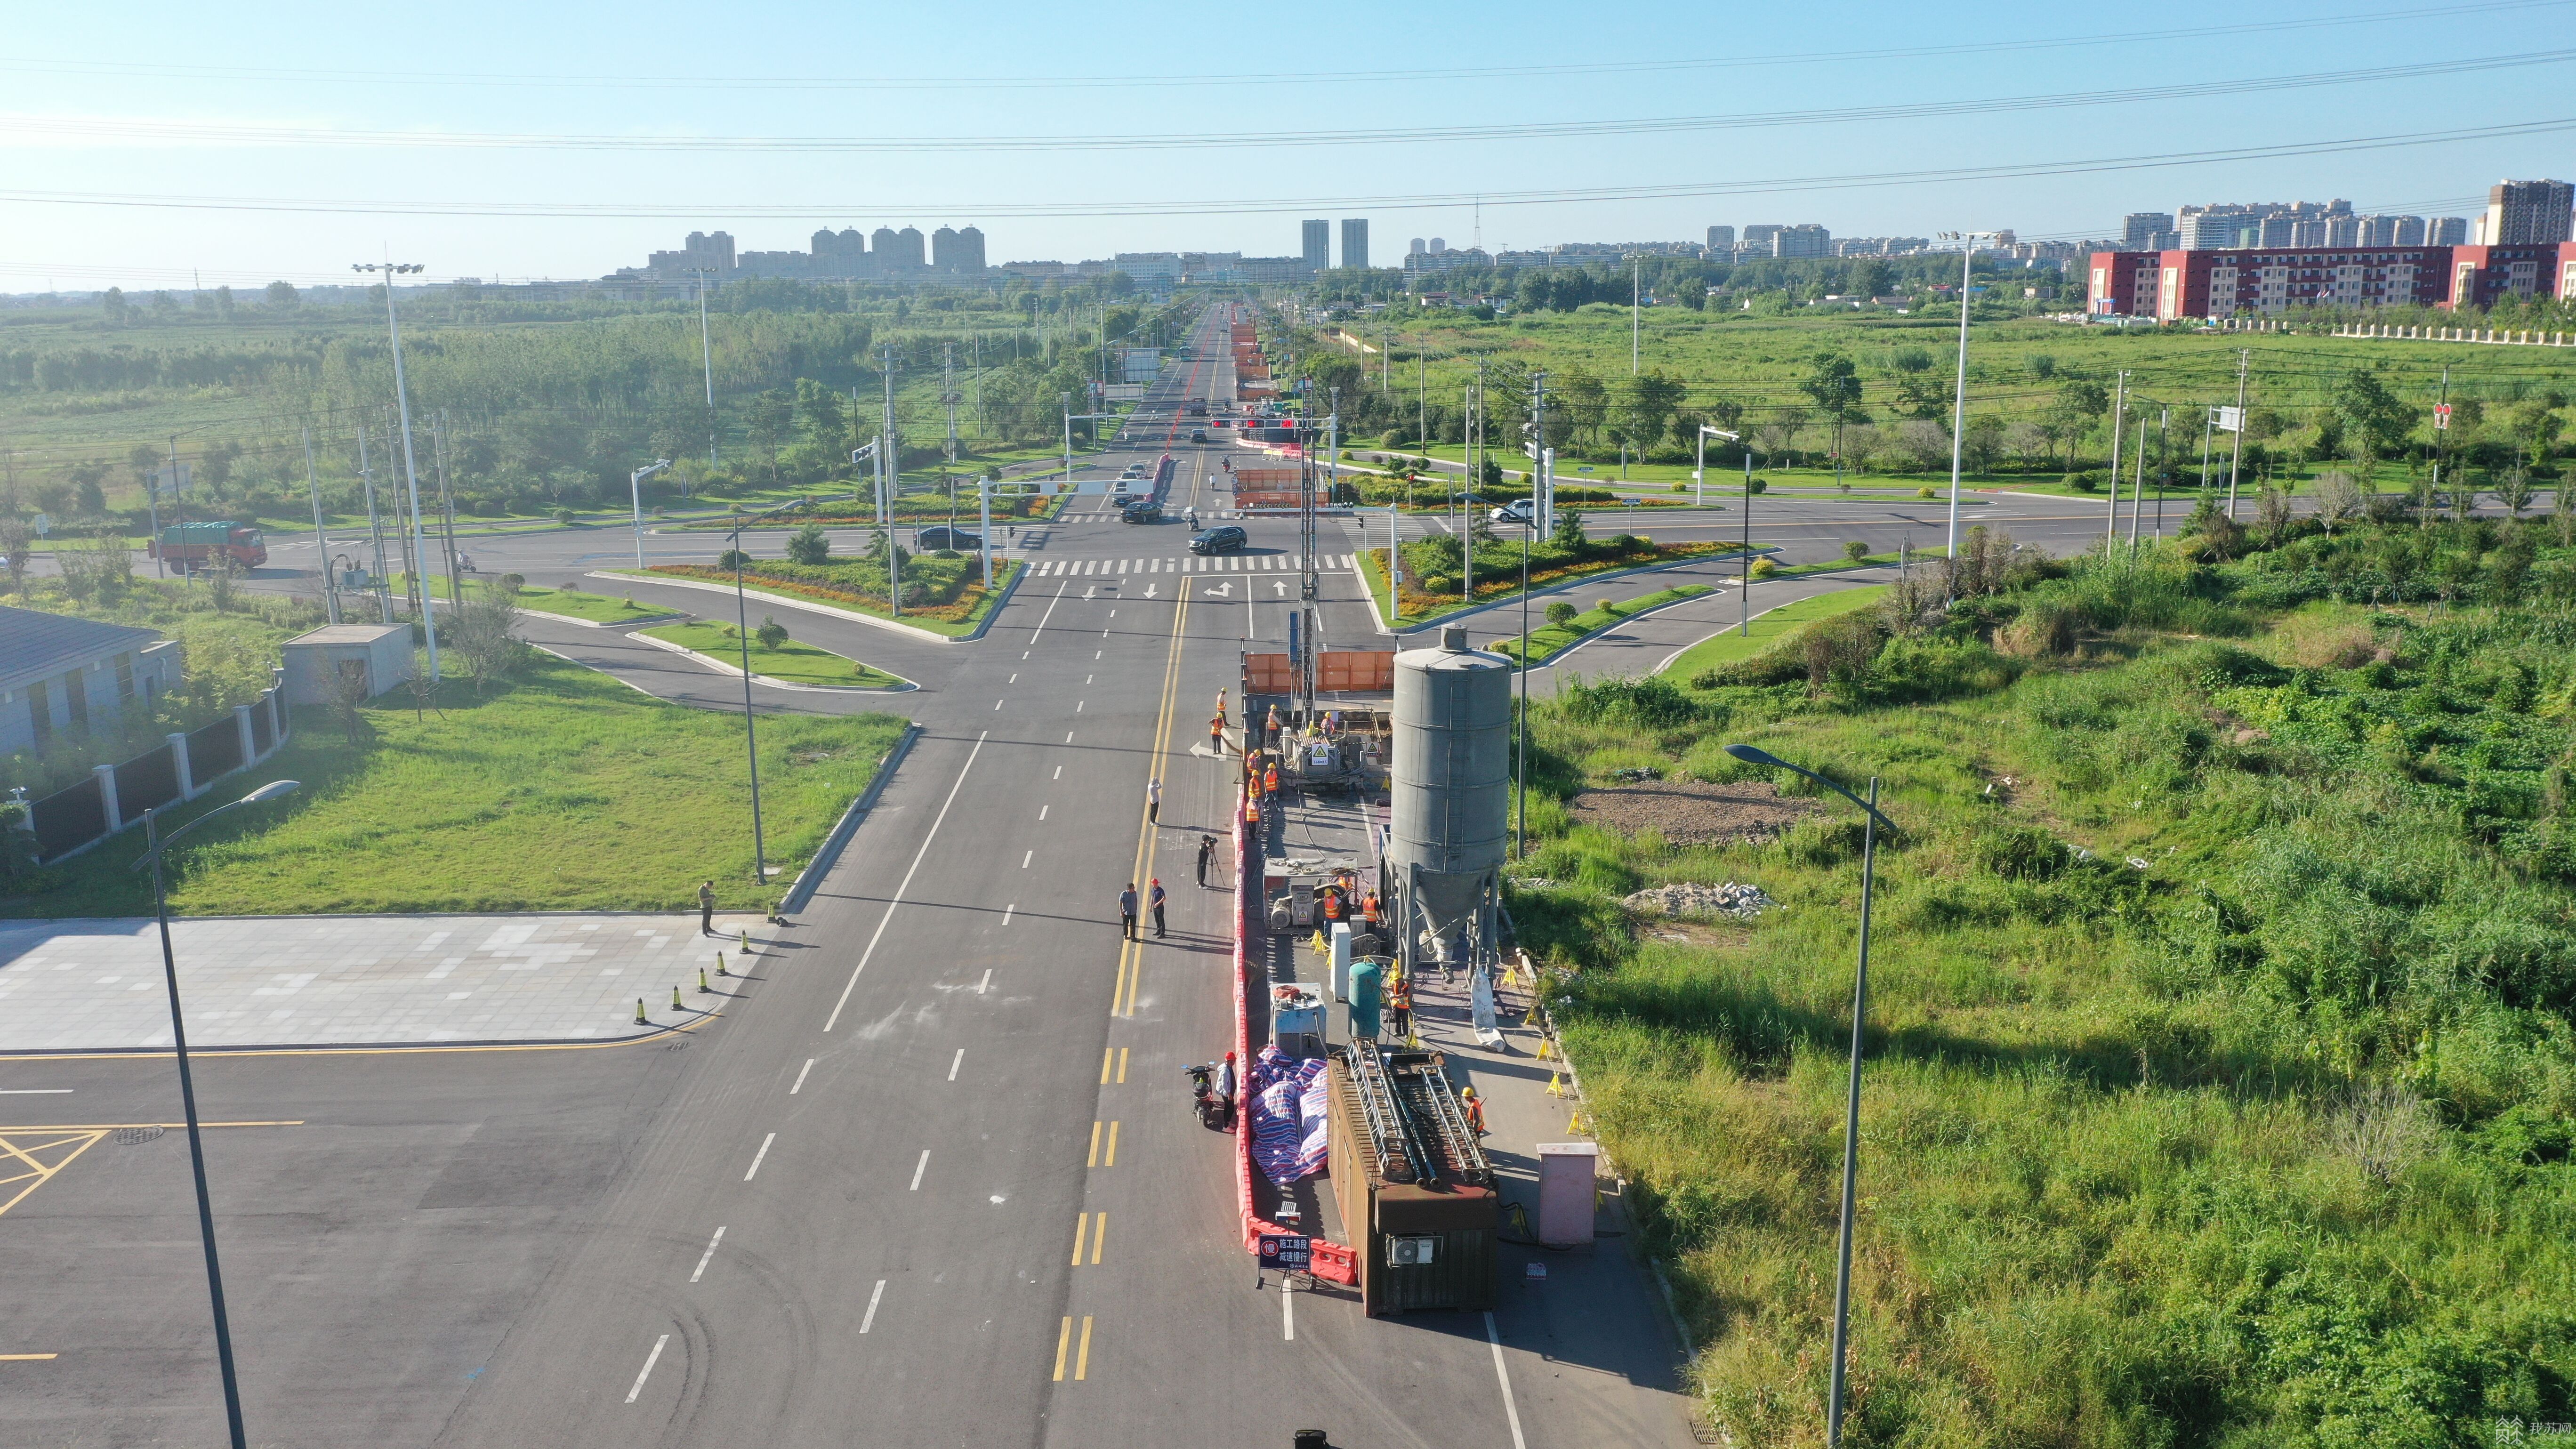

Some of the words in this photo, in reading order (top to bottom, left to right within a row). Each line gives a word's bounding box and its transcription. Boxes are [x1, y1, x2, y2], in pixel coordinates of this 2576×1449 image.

[1264, 1243, 1275, 1254] 慢
[1279, 1238, 1307, 1250] 施工路段
[1279, 1251, 1307, 1263] 减速慢行
